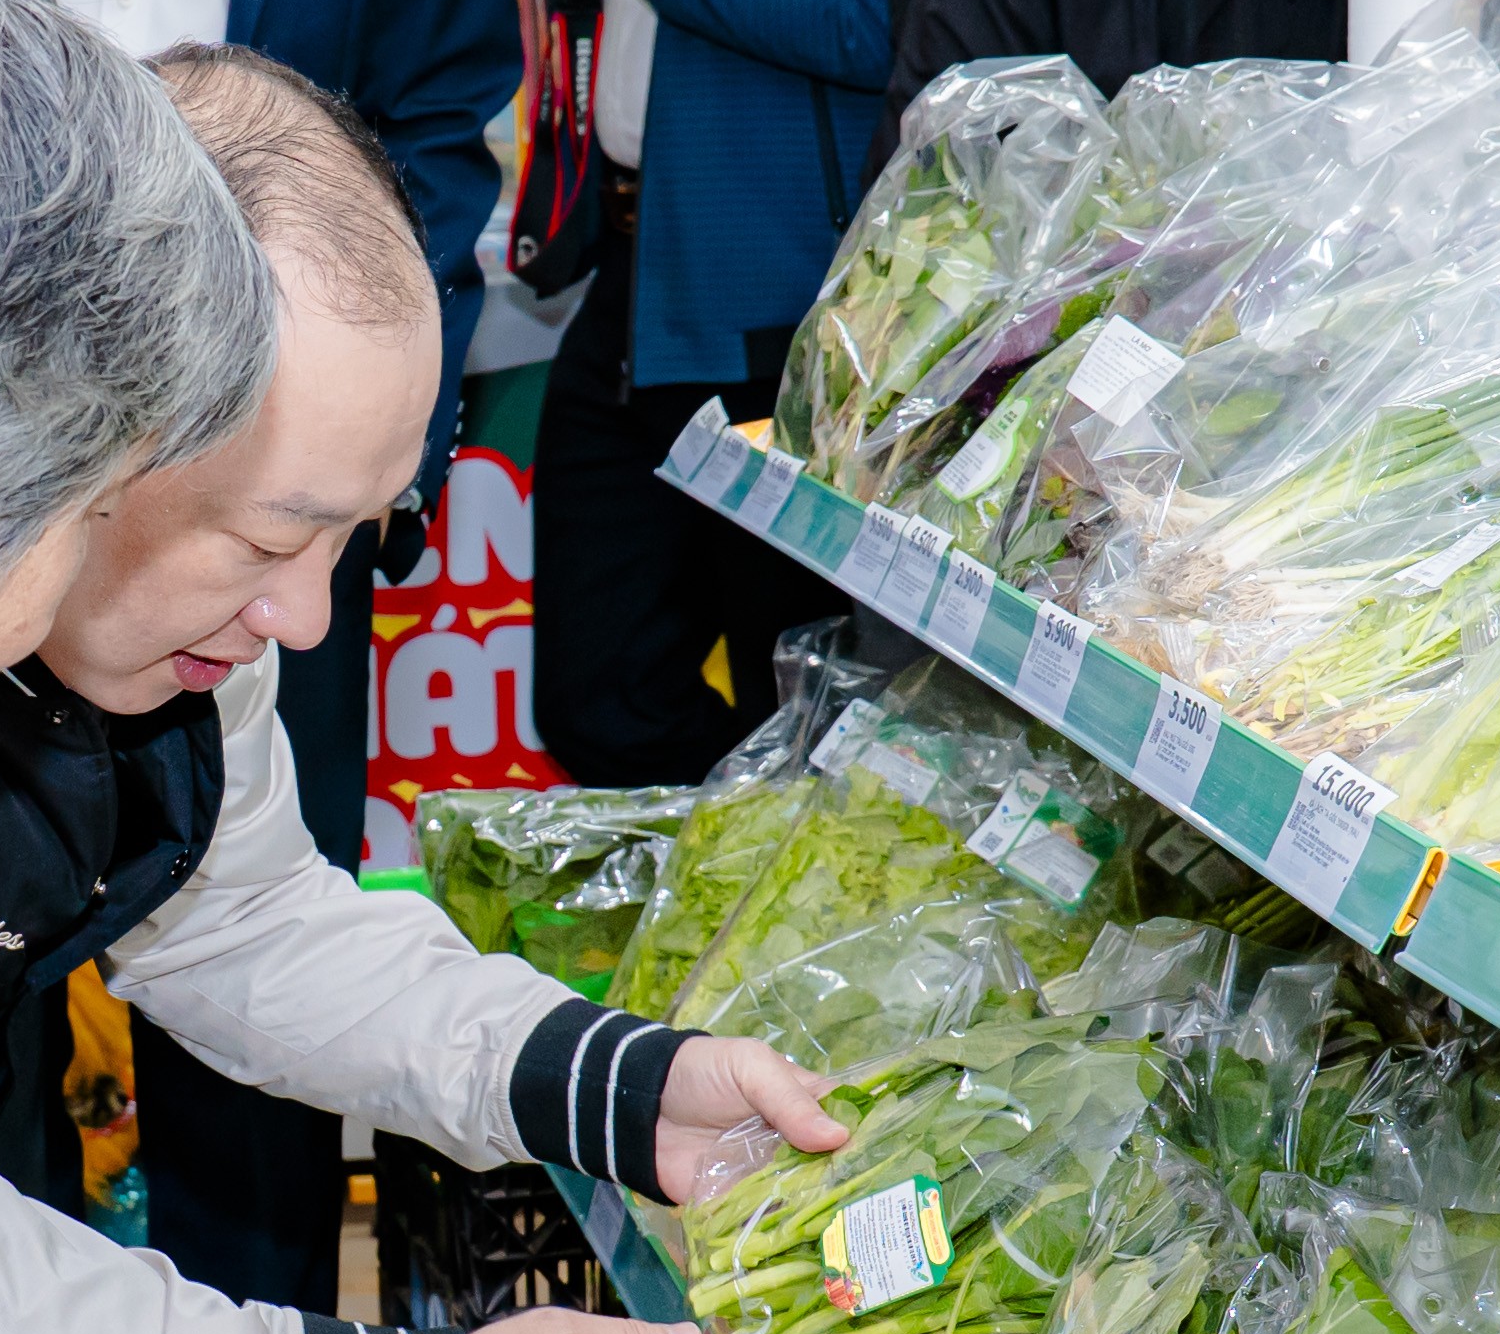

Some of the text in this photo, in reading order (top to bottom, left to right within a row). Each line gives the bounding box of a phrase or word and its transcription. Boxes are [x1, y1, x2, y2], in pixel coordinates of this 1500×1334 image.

[1044, 613, 1077, 651] 5.900
[1168, 690, 1207, 735] 3.500
[1312, 765, 1375, 818] 15.000
